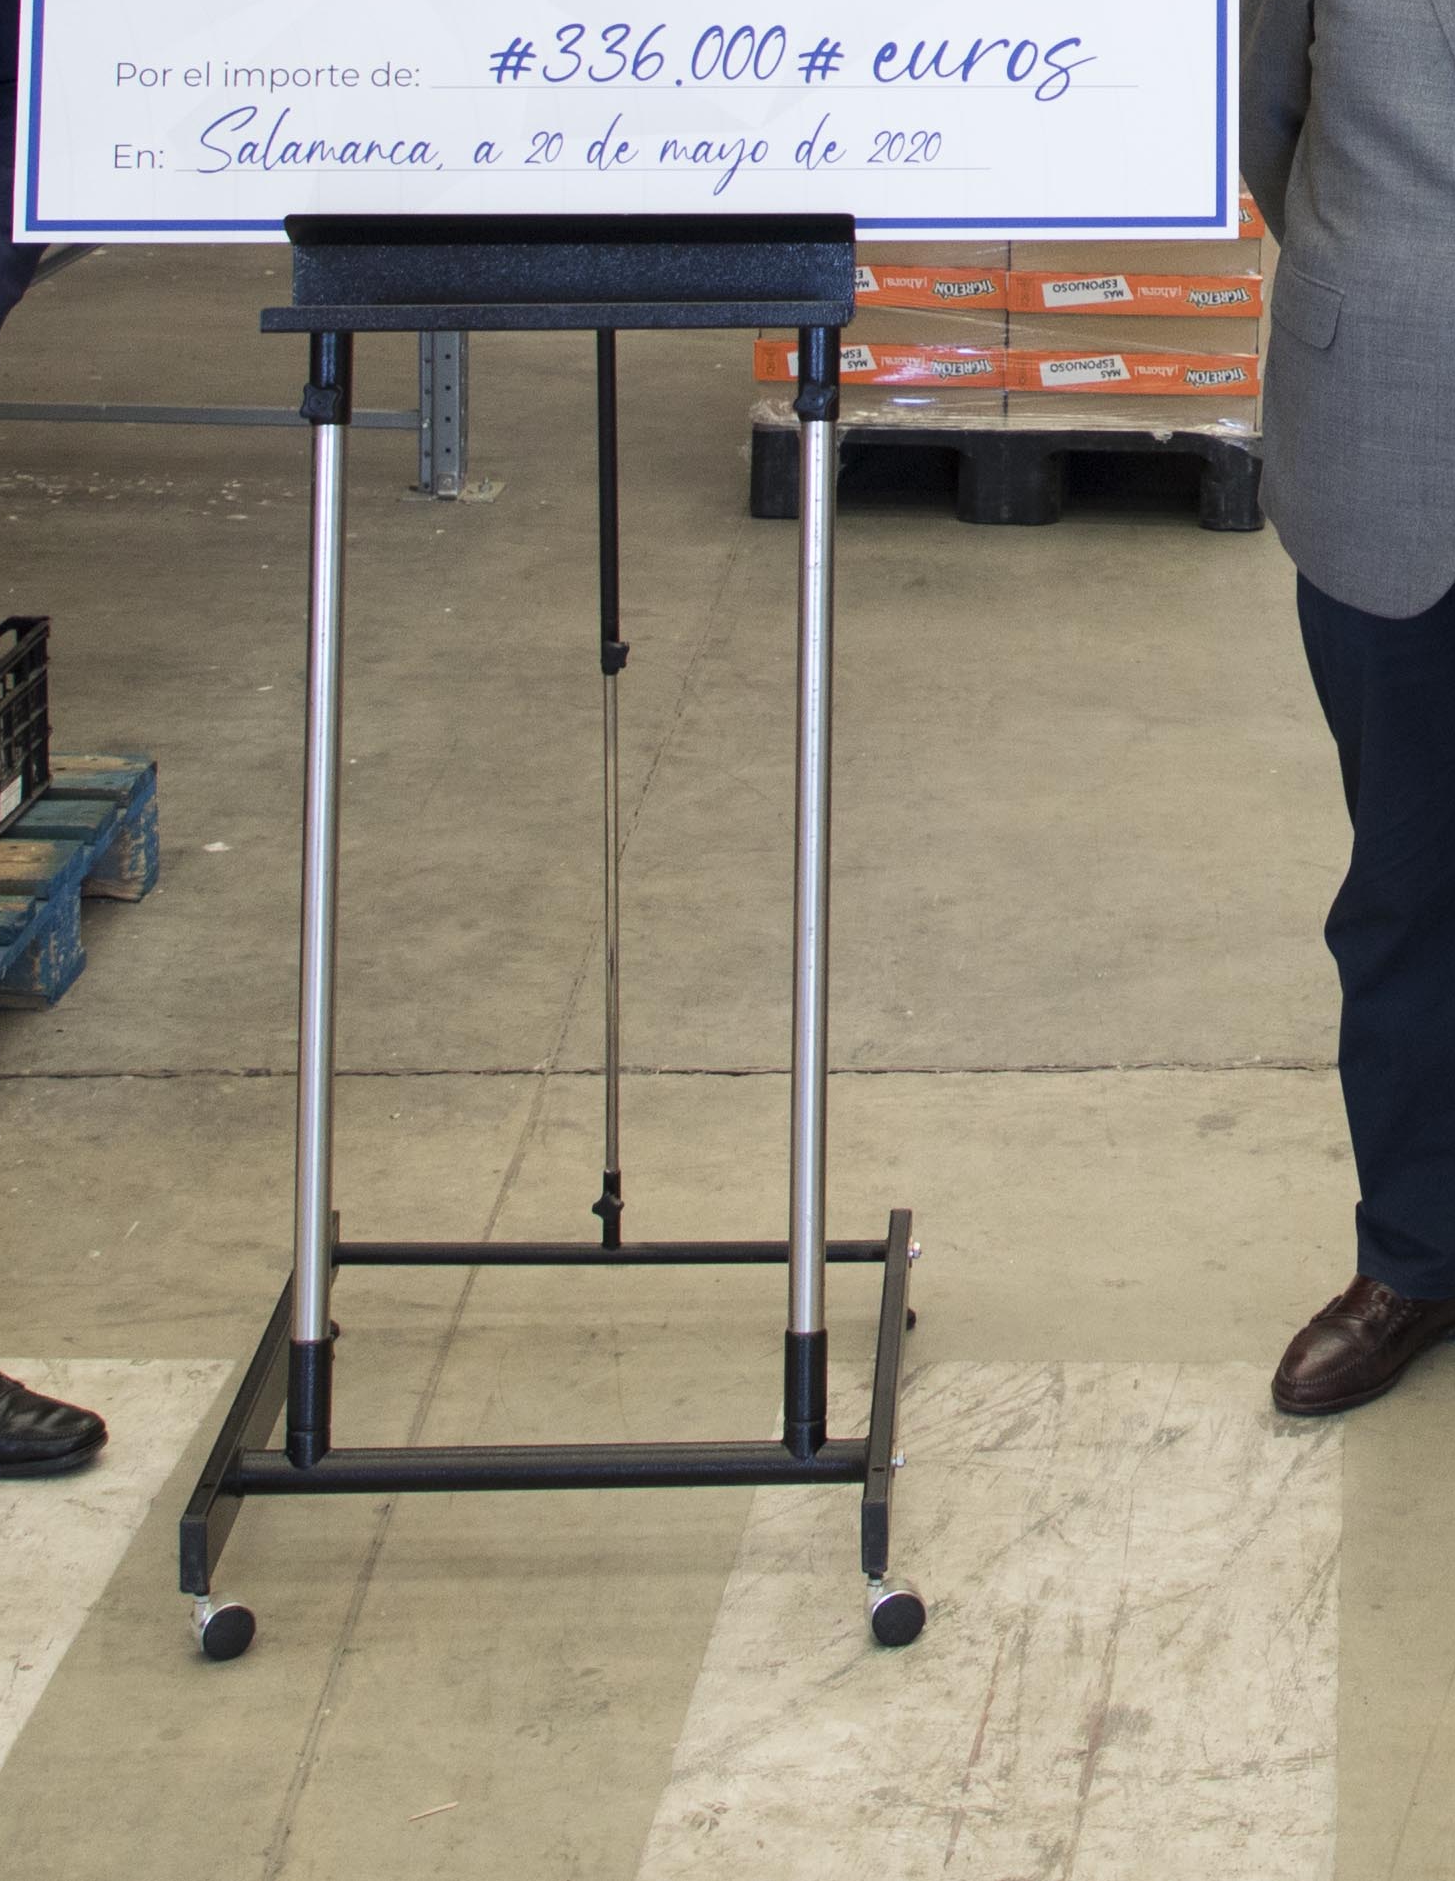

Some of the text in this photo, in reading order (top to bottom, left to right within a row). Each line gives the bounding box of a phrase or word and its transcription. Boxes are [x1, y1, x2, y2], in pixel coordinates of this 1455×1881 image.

[115, 61, 172, 88] Por
[183, 60, 211, 88] el
[224, 60, 360, 94] importe
[370, 60, 422, 88] de:
[872, 35, 1098, 103] euros
[114, 105, 943, 196] En: Salamanca, a 20 de mayo de 2020
[882, 276, 928, 290] ¡Ahora!
[932, 278, 997, 300] TIGRETÓN
[1052, 278, 1119, 294] ESPONJOSO
[1103, 289, 1124, 301] MÁS
[1137, 285, 1183, 299] ¡Ahora!
[1186, 285, 1252, 309] TIGRETÓN
[929, 358, 994, 381] TIGRETÓN
[1050, 359, 1117, 373] ESPONJOSO
[1099, 368, 1122, 380] MÁS
[1133, 364, 1179, 379] ¡Ahora!
[1183, 365, 1249, 389] TIGRETÓN
